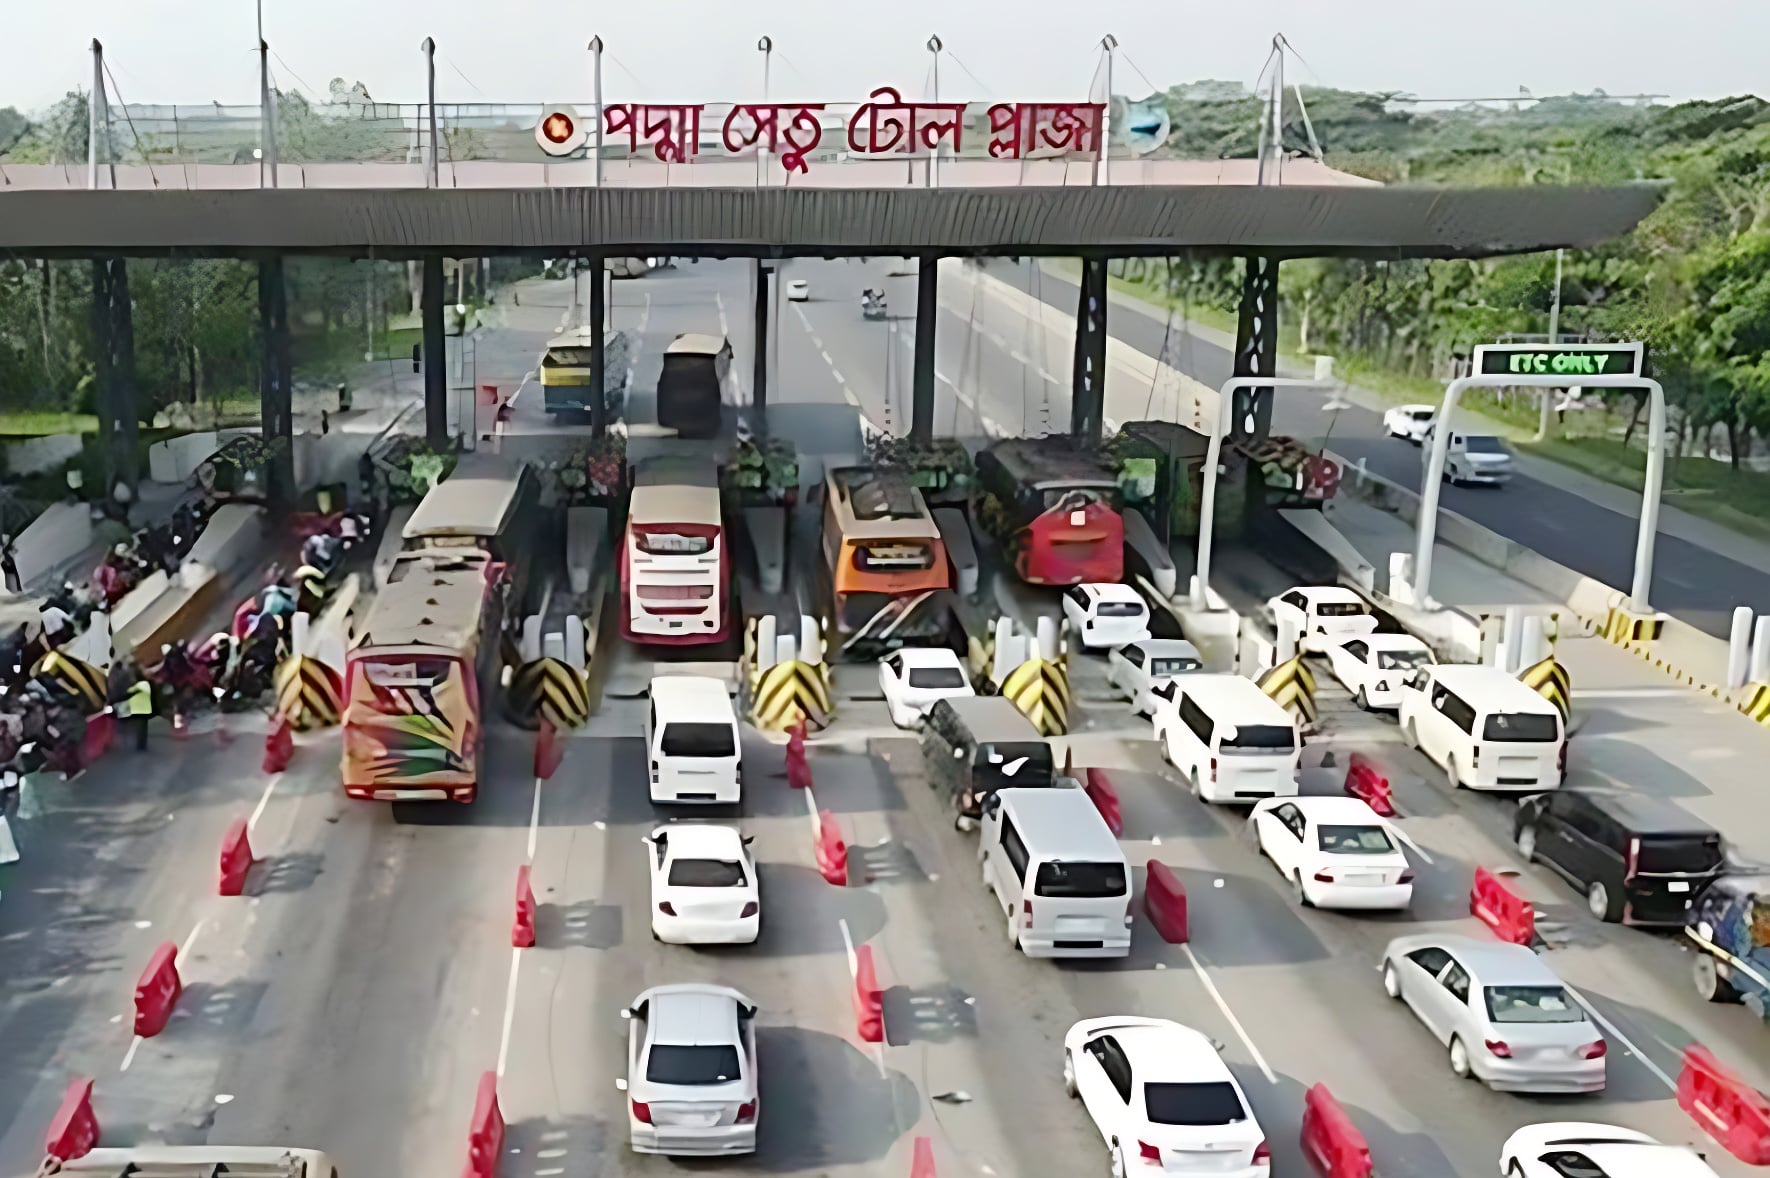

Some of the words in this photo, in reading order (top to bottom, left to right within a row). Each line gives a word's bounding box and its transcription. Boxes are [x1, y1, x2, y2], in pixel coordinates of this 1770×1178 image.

[603, 104, 705, 164] পদ্মা
[722, 104, 826, 174] সেতু
[847, 87, 967, 154] টোল
[987, 103, 1106, 158] প্লাজা
[1551, 352, 1609, 374] ONLY
